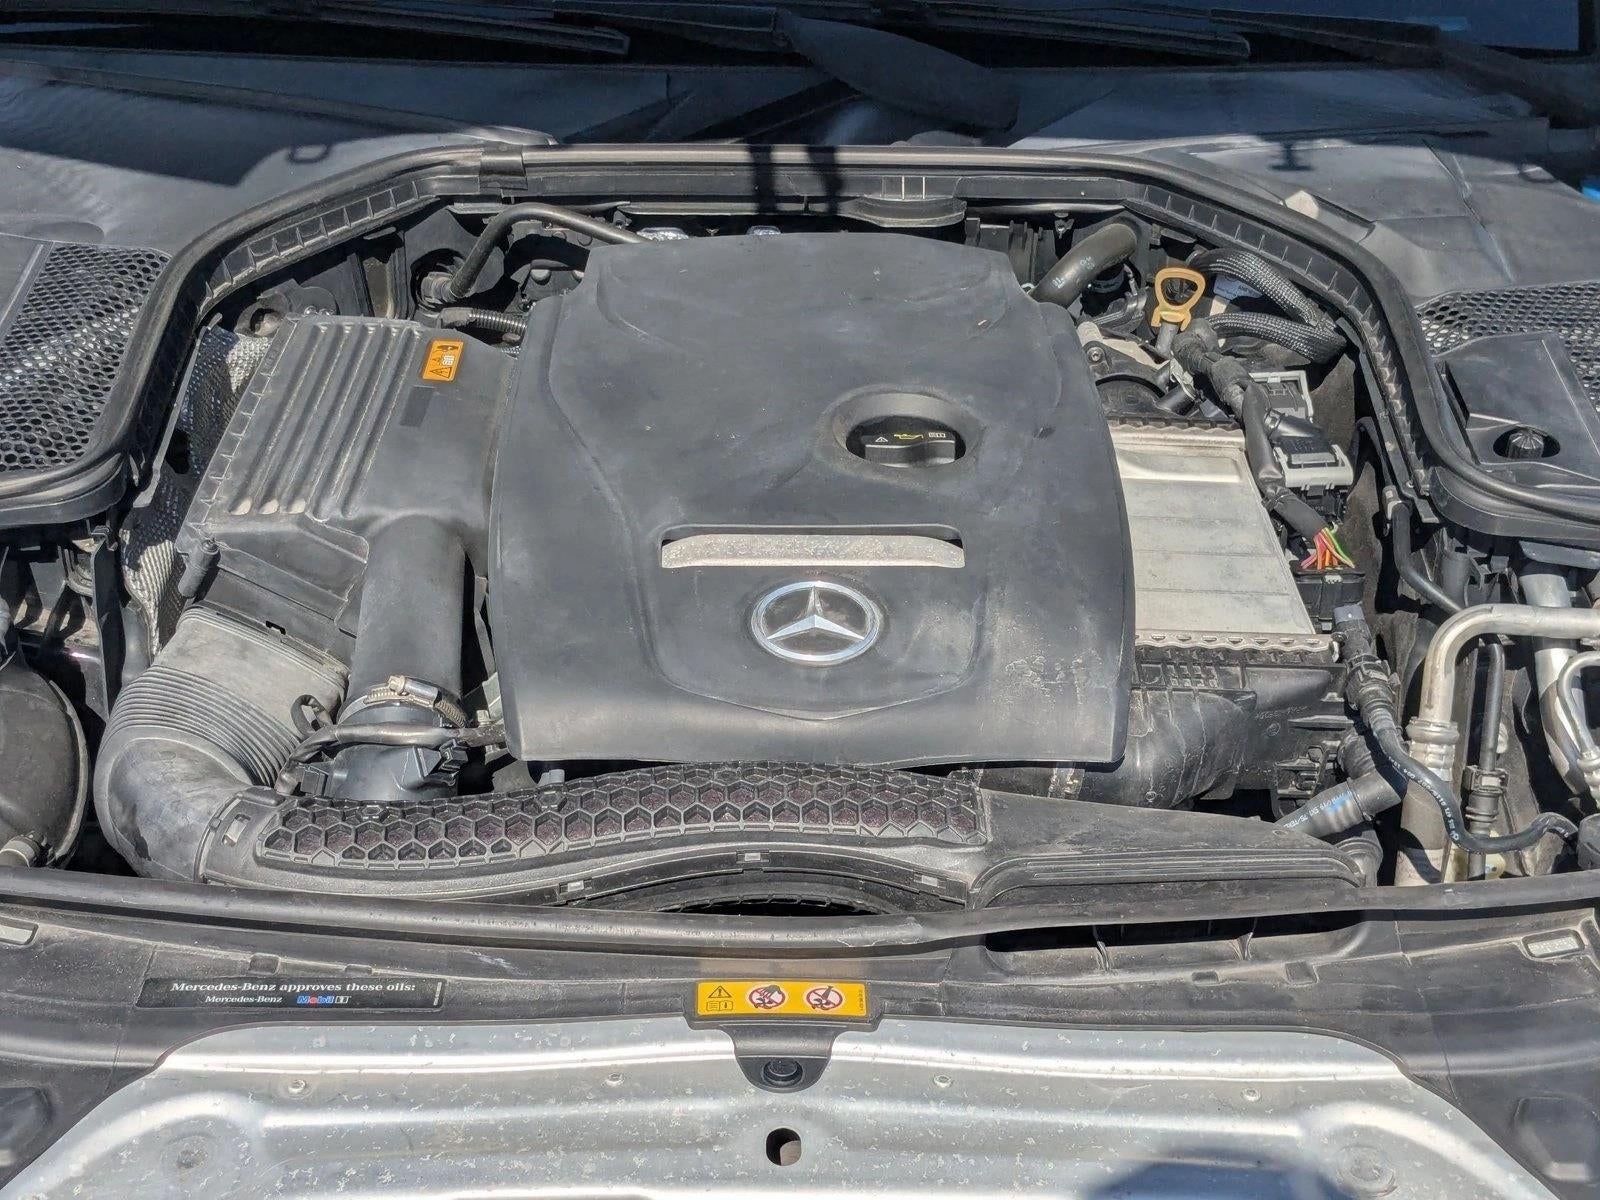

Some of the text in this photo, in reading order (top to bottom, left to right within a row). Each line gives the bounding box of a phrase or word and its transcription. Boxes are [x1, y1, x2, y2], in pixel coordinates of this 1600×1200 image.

[170, 982, 416, 993] Mercedes-Benz approves these oils:
[205, 995, 282, 1003] Mercedes-Benz
